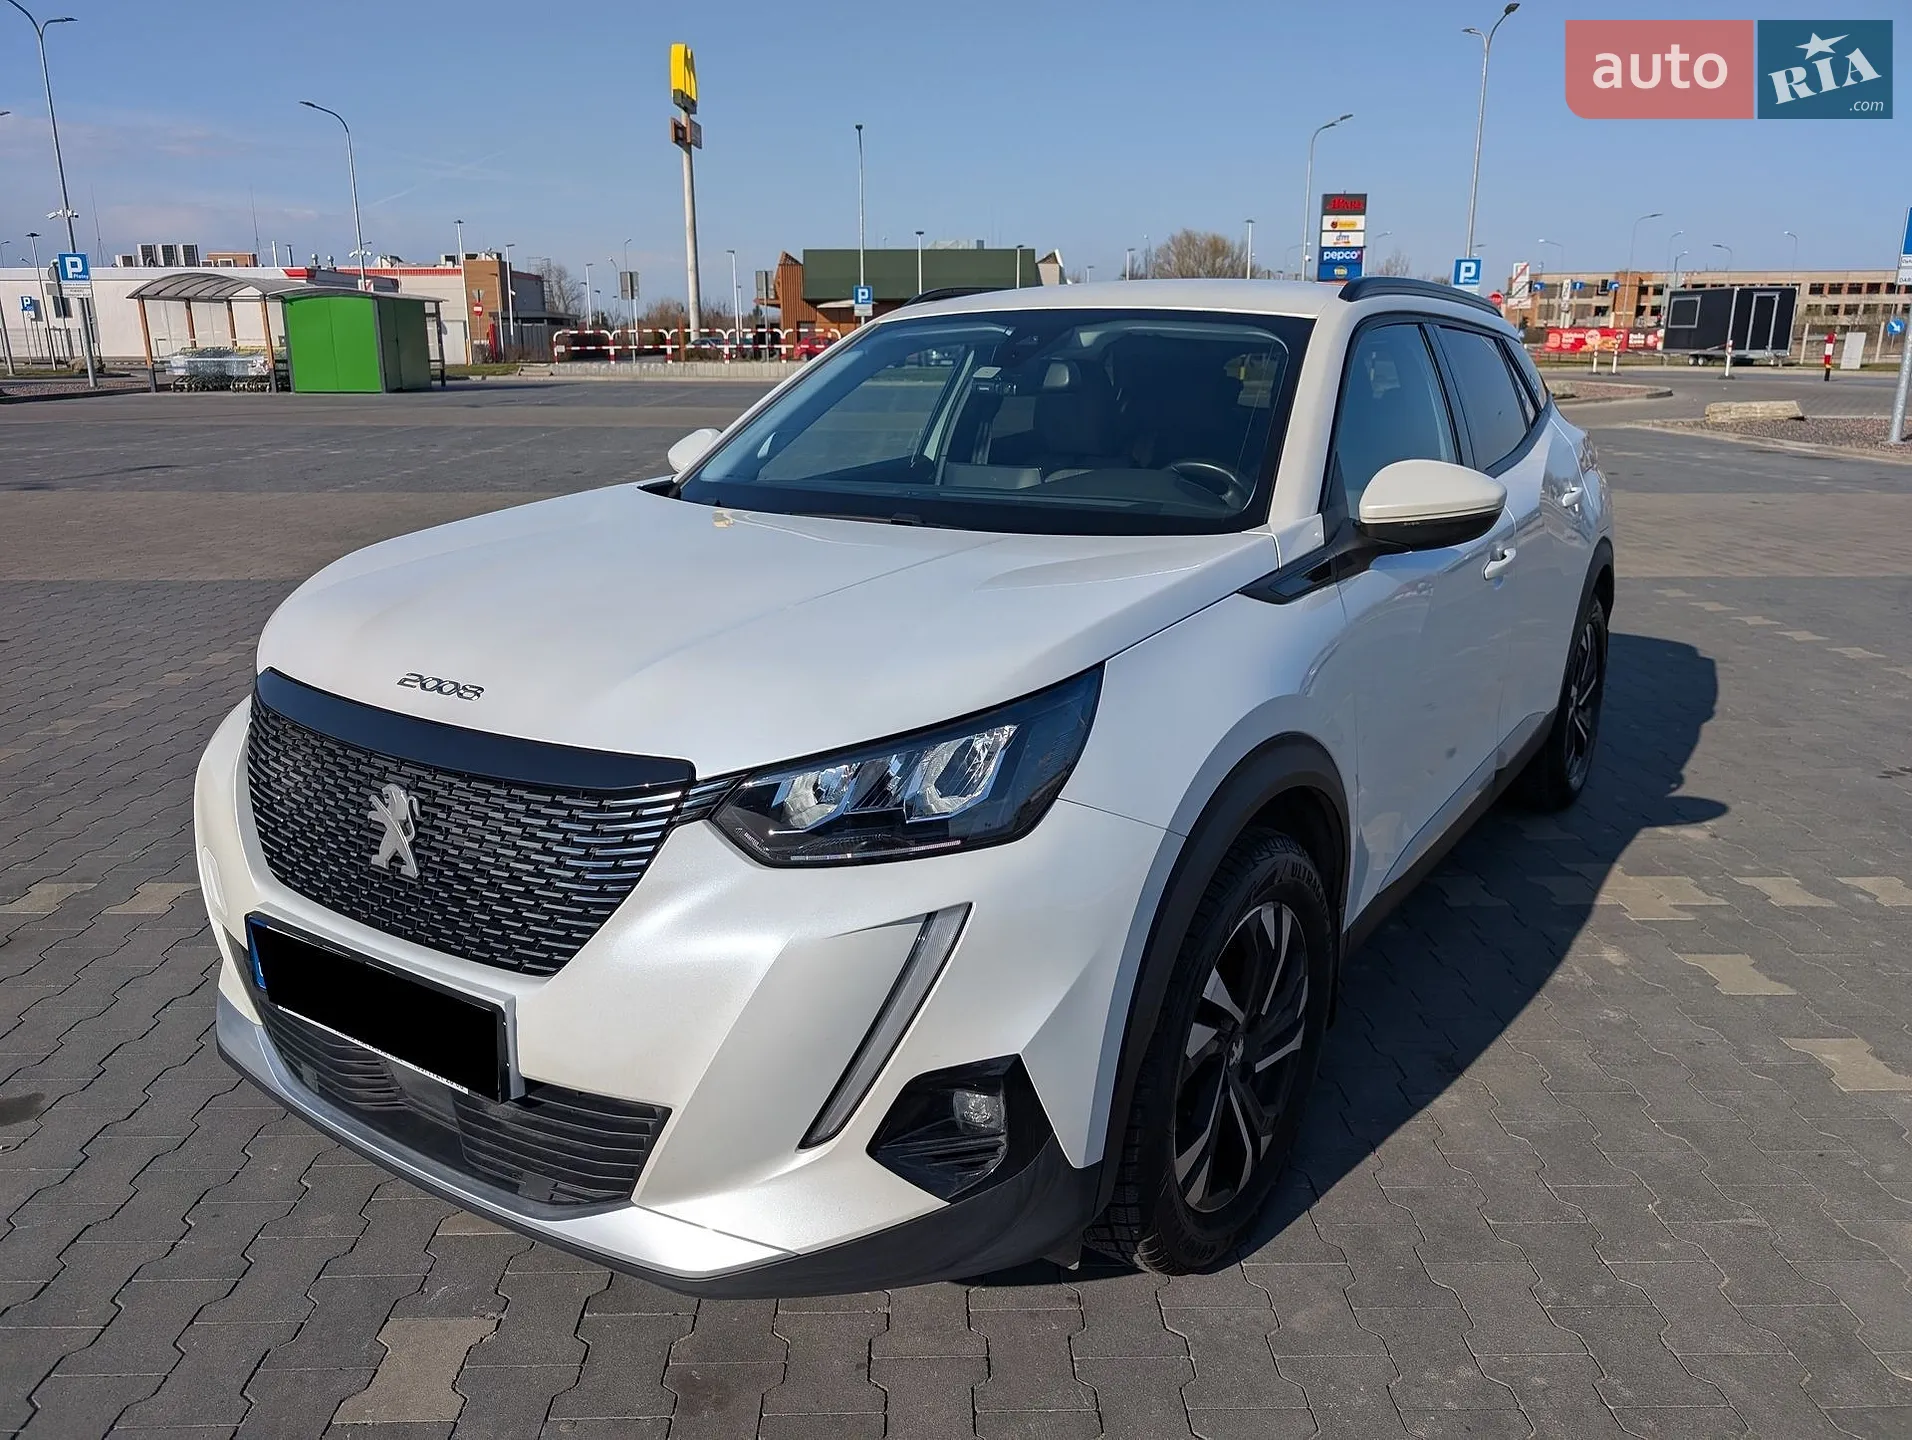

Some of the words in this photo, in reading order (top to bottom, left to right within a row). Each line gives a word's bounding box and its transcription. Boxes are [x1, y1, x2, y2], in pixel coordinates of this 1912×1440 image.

[1323, 251, 1358, 261] pepco
[65, 257, 83, 278] P
[1459, 262, 1476, 283] P
[23, 297, 31, 307] P
[858, 288, 868, 303] P
[397, 673, 484, 701] 2008
